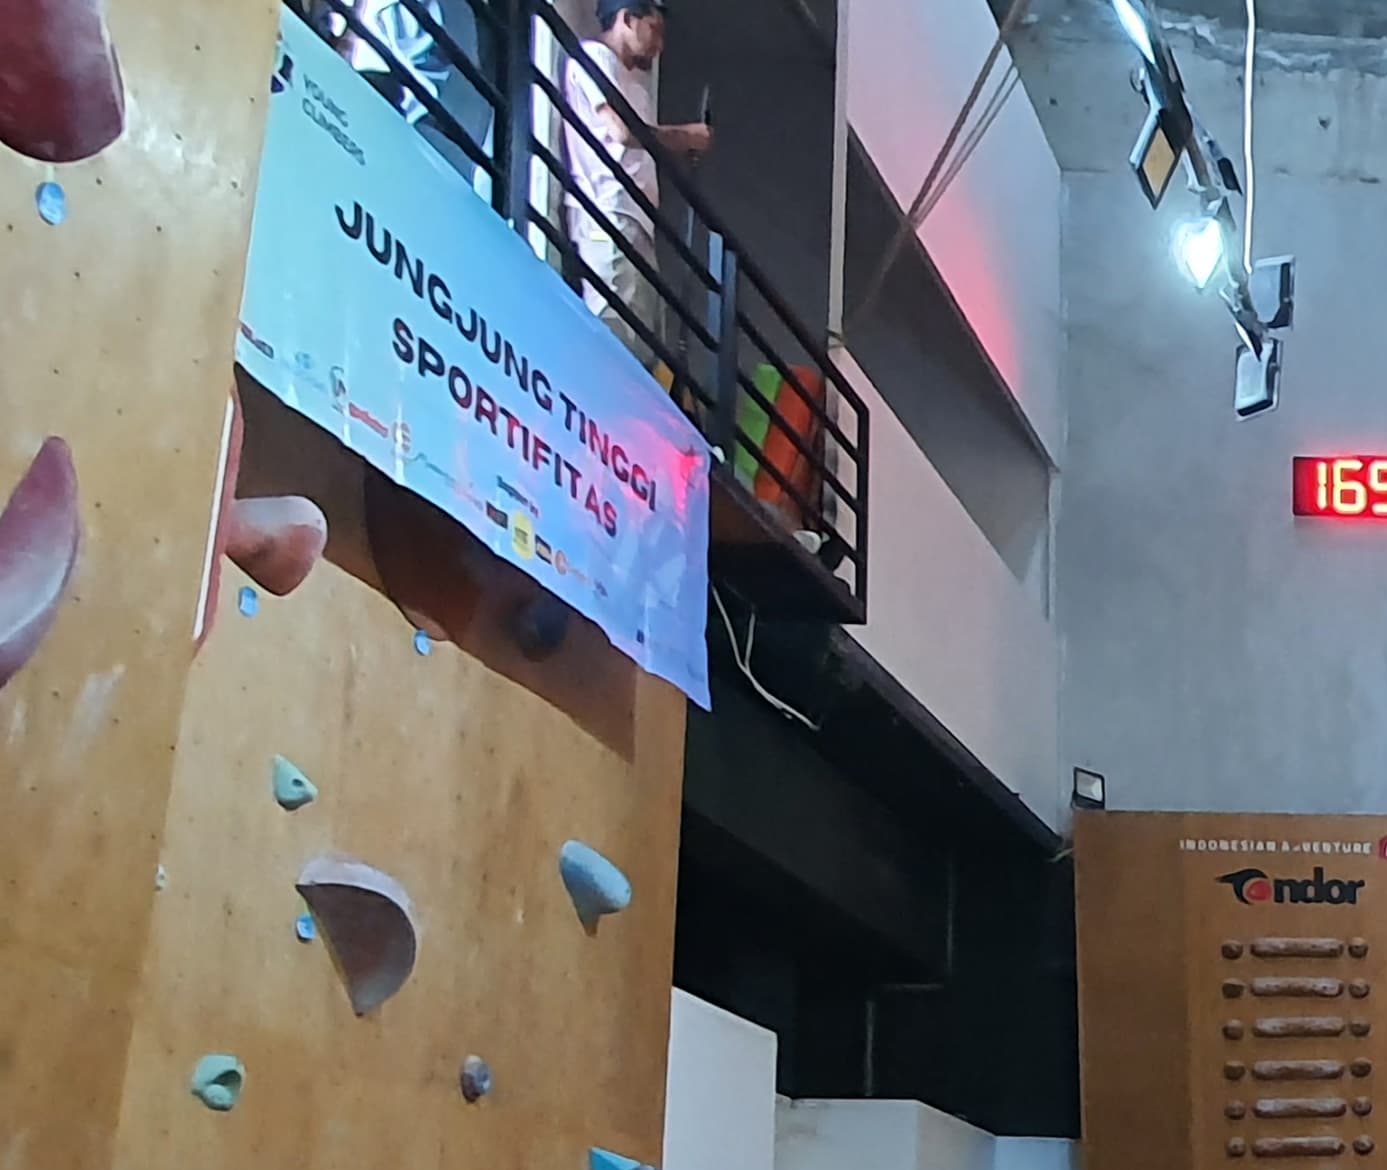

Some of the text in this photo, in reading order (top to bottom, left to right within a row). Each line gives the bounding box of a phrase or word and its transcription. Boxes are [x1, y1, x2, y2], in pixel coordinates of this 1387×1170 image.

[335, 200, 656, 513] JUNGJUNG TINGGI
[391, 317, 618, 538] SPORTIFITAS
[1179, 839, 1276, 852] INDONESIAN
